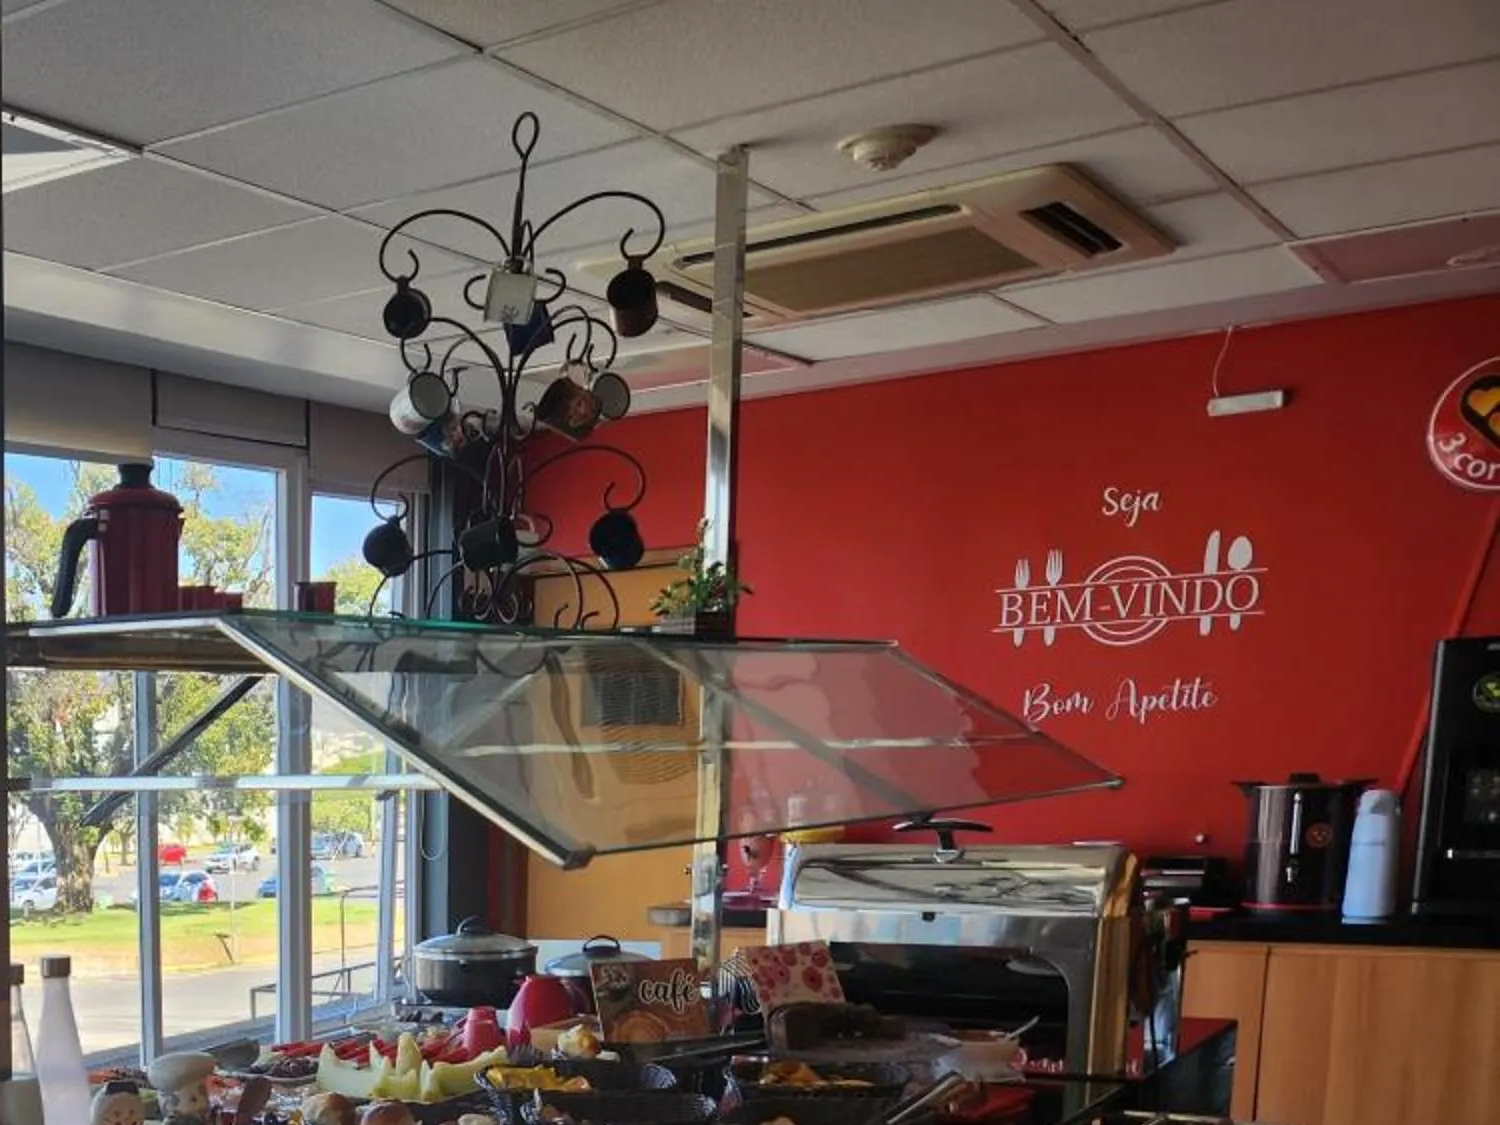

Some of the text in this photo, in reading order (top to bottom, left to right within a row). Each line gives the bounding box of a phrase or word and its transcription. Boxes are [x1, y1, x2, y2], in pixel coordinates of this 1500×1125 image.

[1438, 431, 1500, 480] 3 cor
[1102, 487, 1160, 528] Seja
[1023, 676, 1218, 725] Bom Apetite
[639, 967, 701, 1015] café
